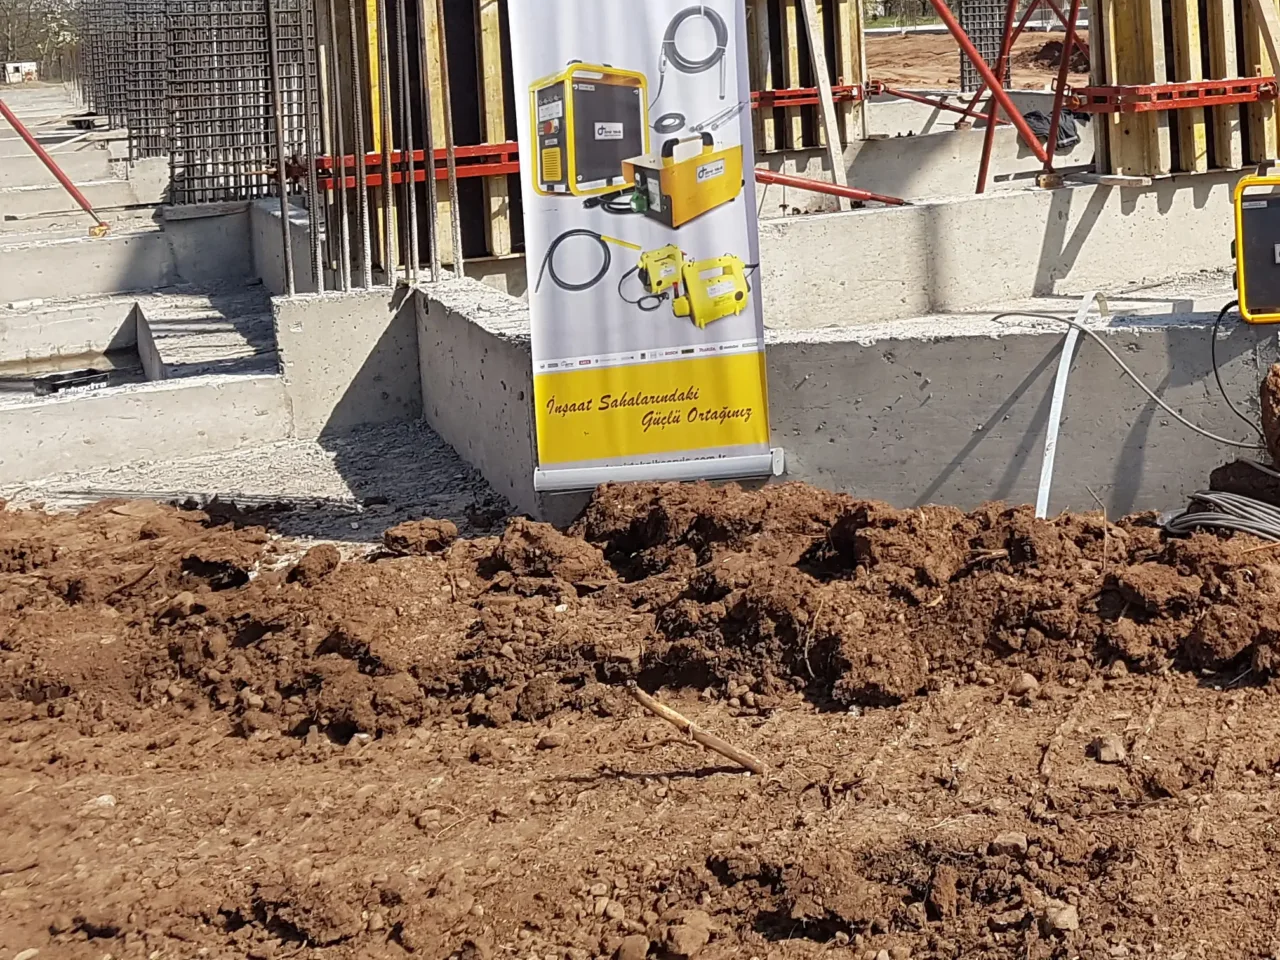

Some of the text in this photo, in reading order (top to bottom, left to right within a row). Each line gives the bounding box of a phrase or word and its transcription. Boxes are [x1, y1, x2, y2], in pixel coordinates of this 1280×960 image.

[546, 385, 700, 417] İnşaat Sahalarındaki
[641, 406, 752, 432] Güçlü Ortağınız
